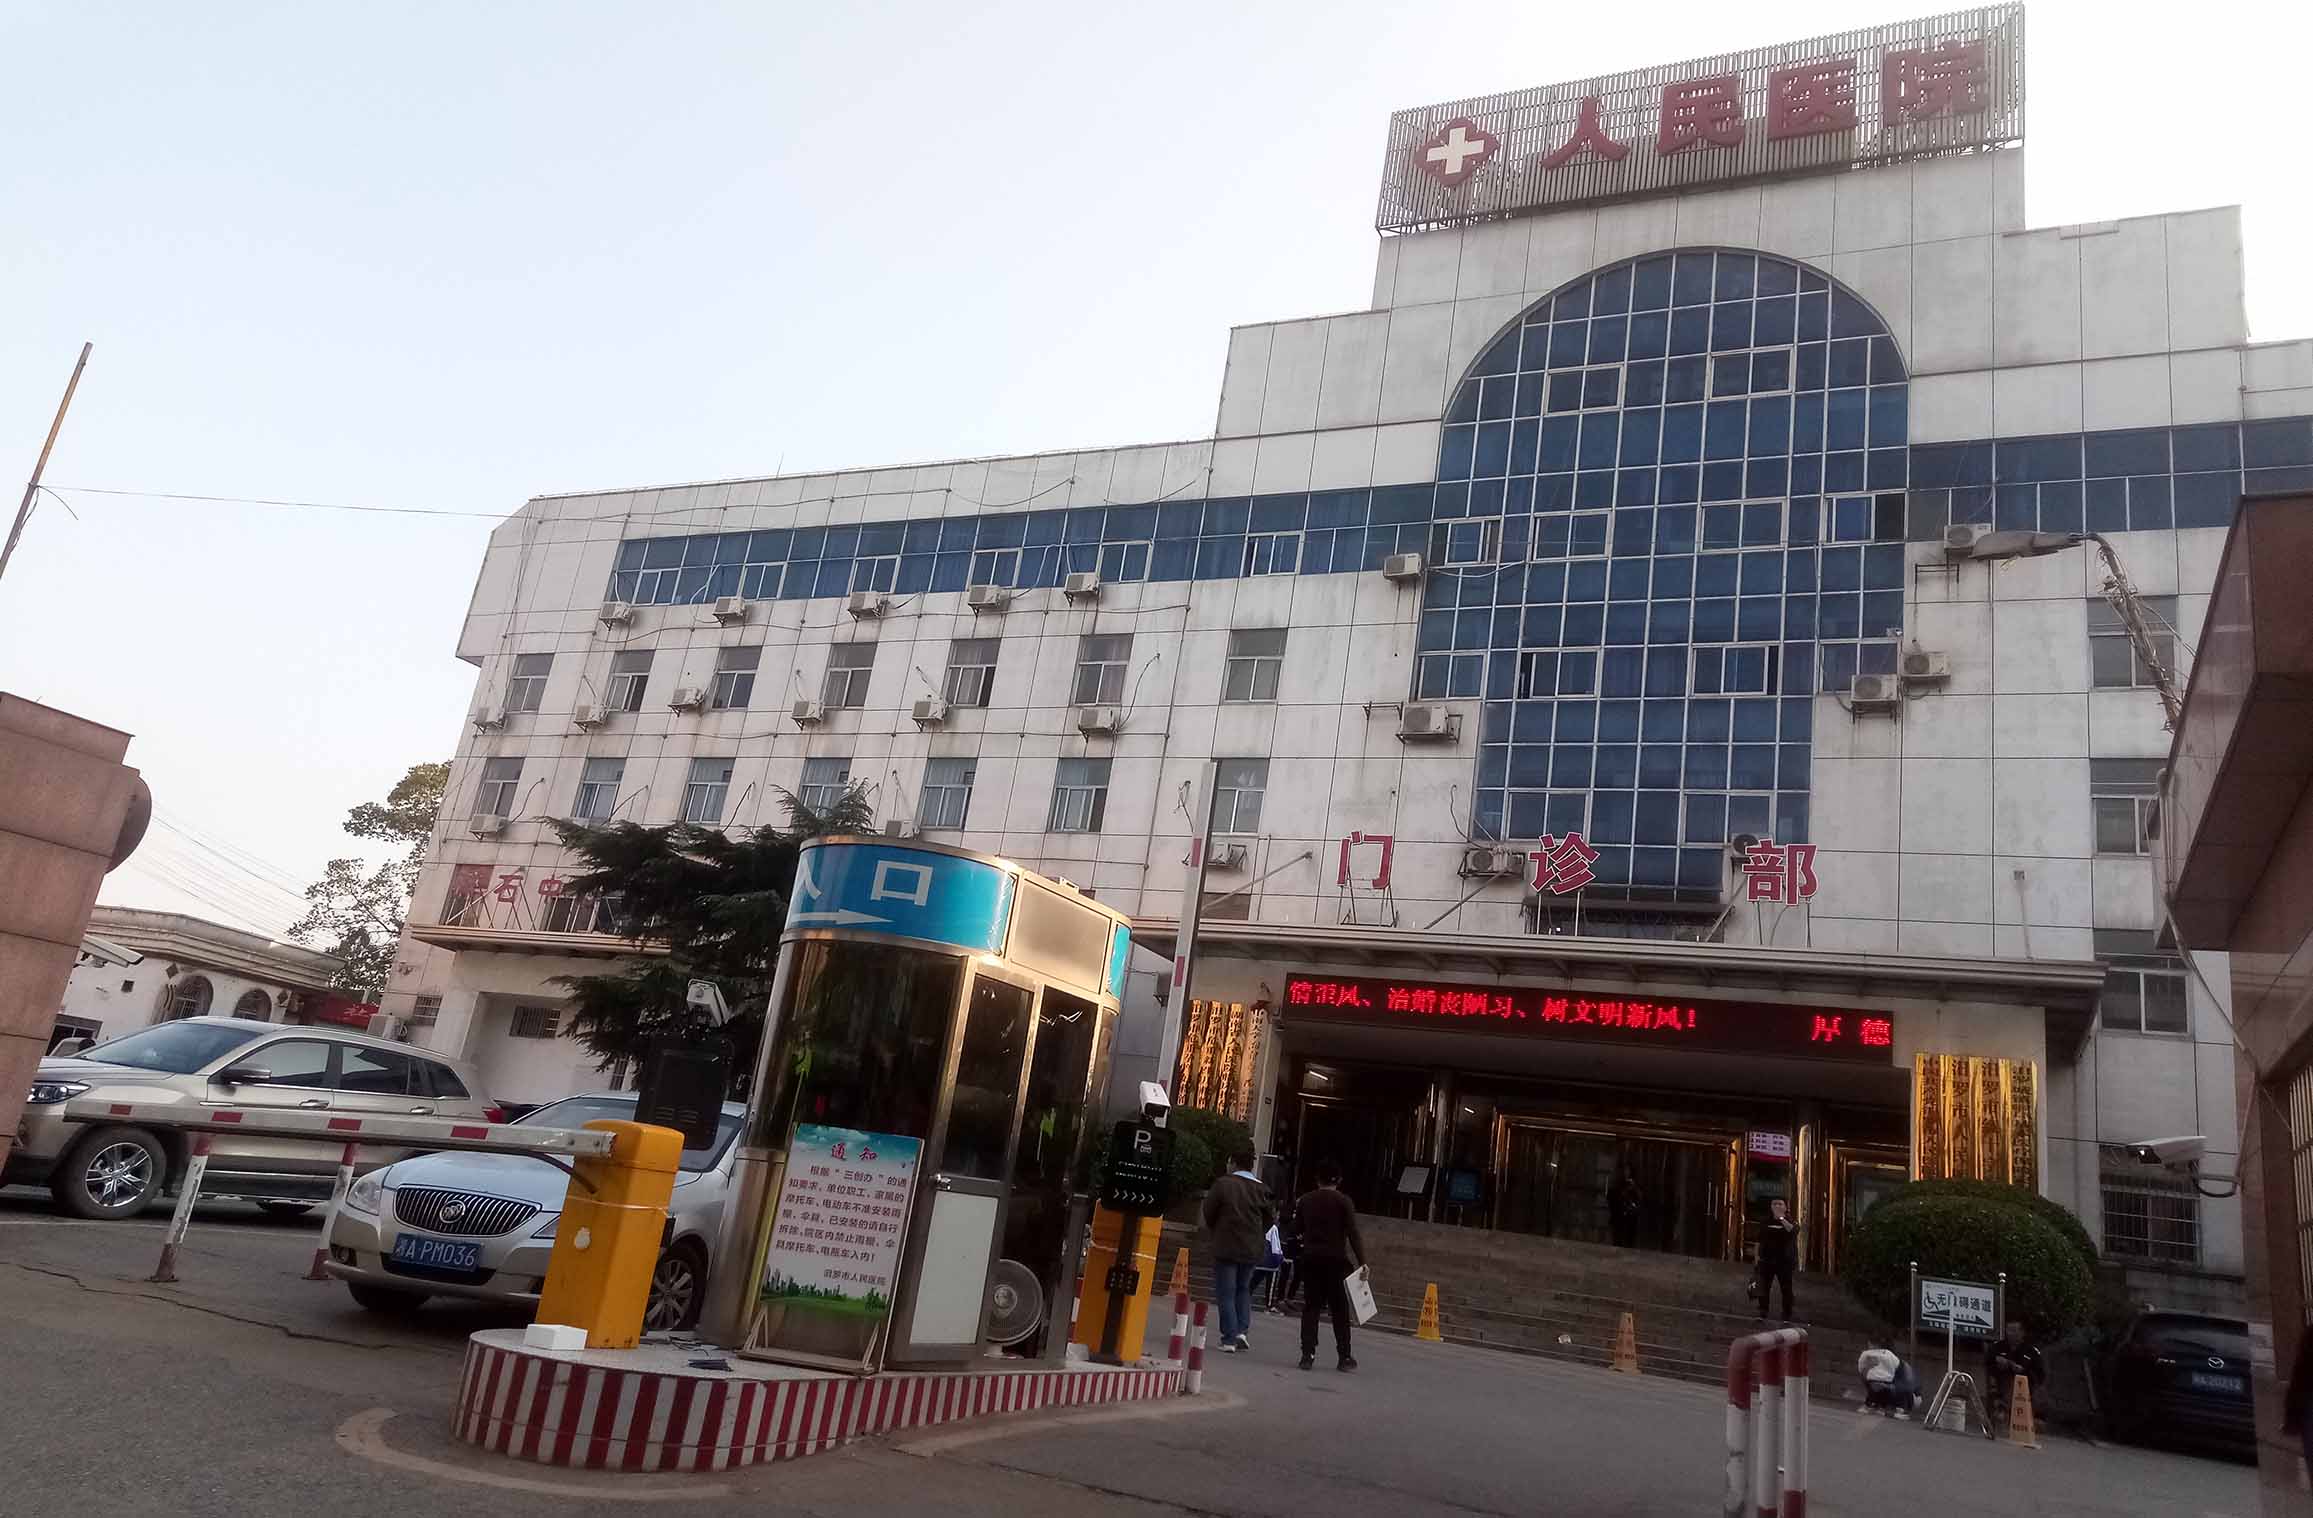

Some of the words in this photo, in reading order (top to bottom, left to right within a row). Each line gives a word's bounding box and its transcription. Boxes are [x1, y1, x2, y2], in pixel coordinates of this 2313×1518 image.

[1540, 39, 1988, 169] 人民医院
[1336, 831, 1818, 906] 门诊部
[831, 1142, 878, 1161] 通知
